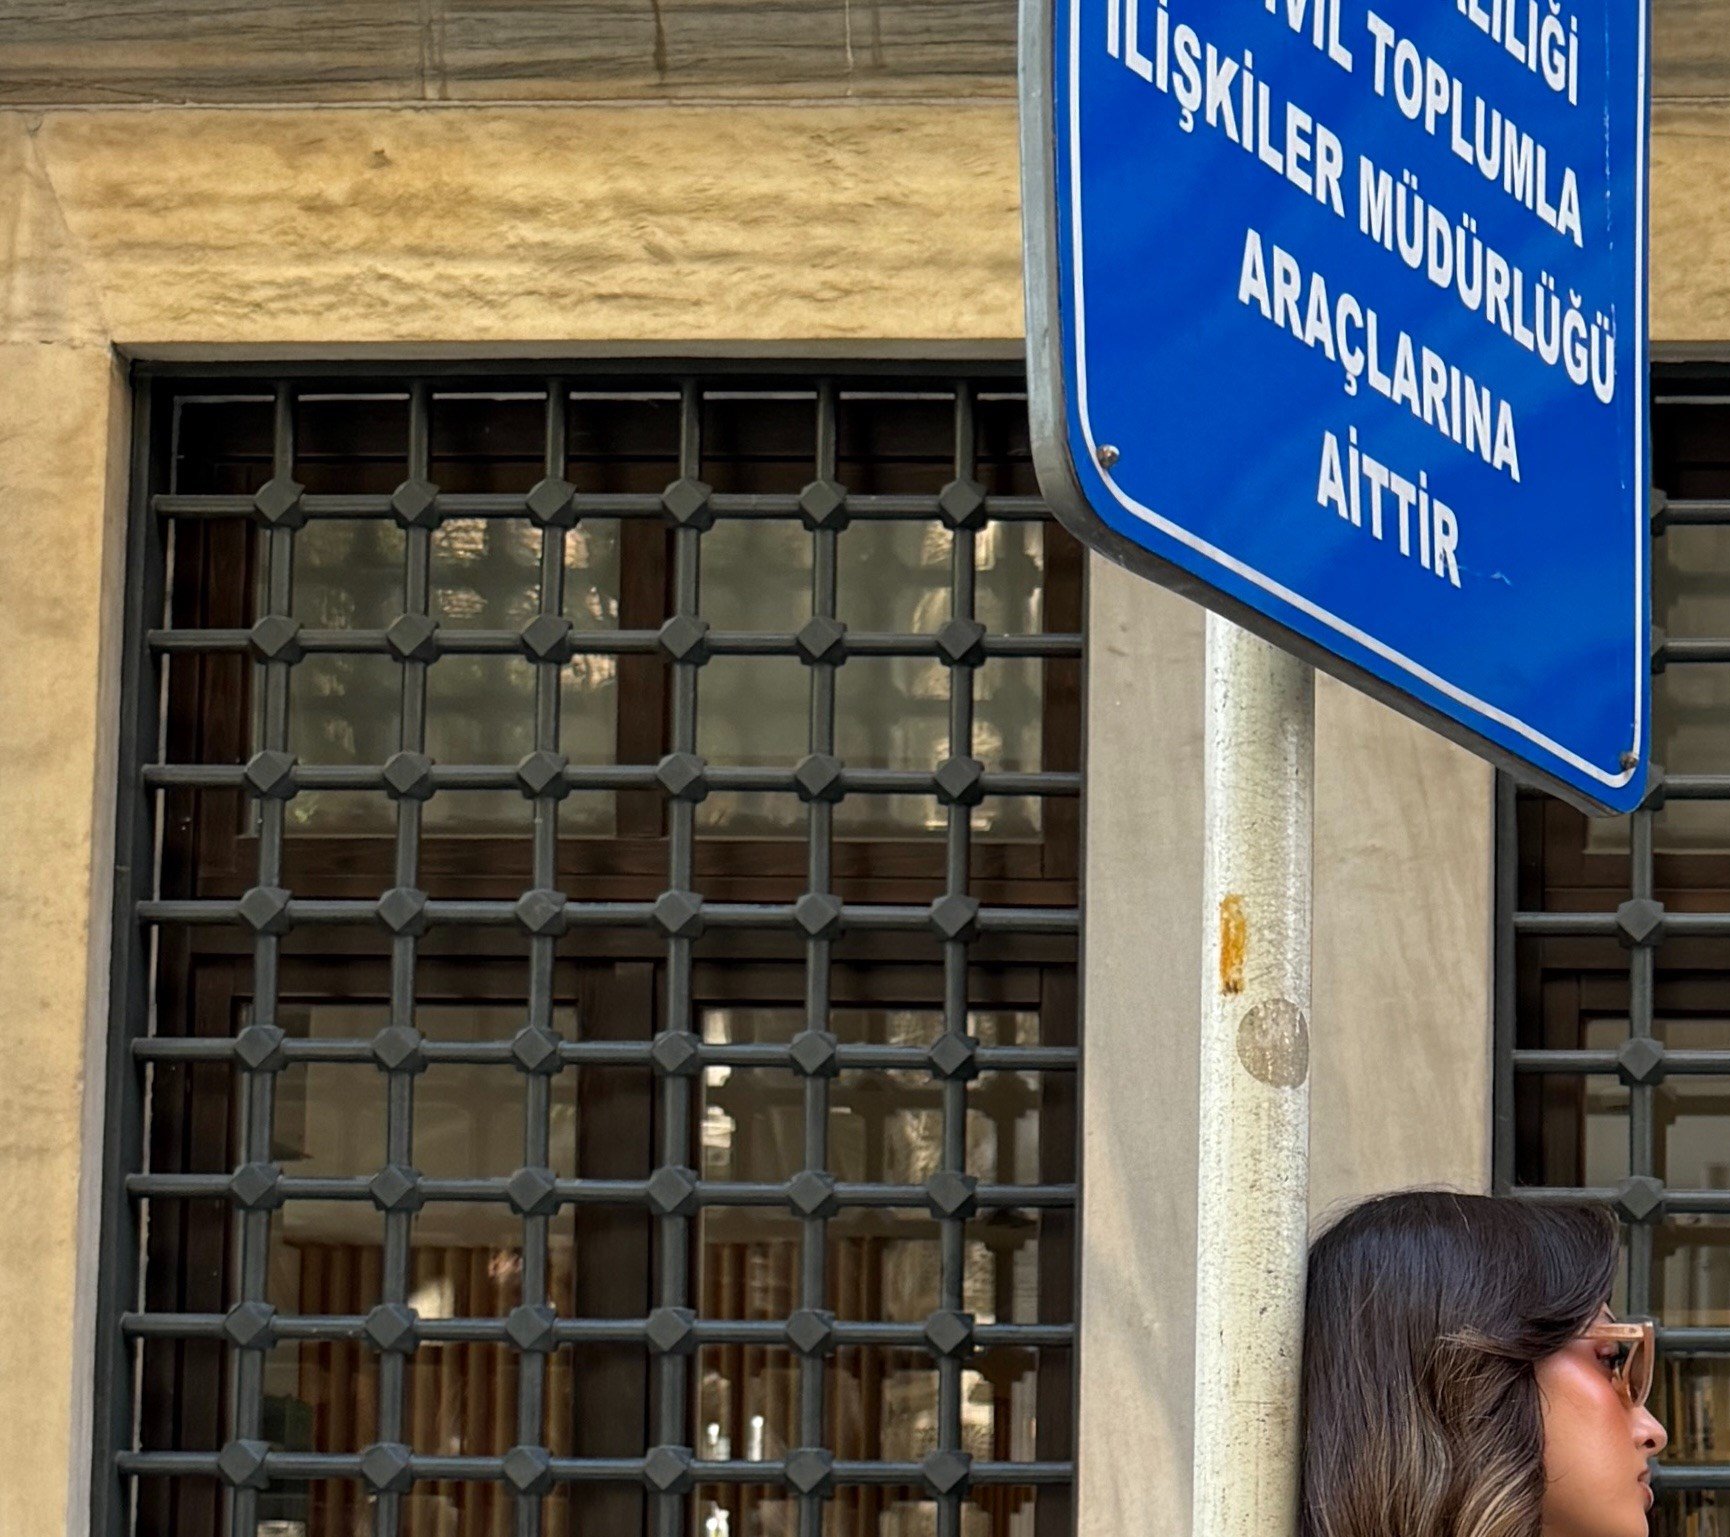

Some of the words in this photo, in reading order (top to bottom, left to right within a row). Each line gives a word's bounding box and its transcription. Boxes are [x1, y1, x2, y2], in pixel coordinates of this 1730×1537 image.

[1367, 10, 1583, 248] TOPLUMLA
[1238, 228, 1521, 483] ARAÇLARINA
[1359, 155, 1615, 404] MÜDÜRLÜĞÜ
[1316, 425, 1461, 588] AİTTİR
